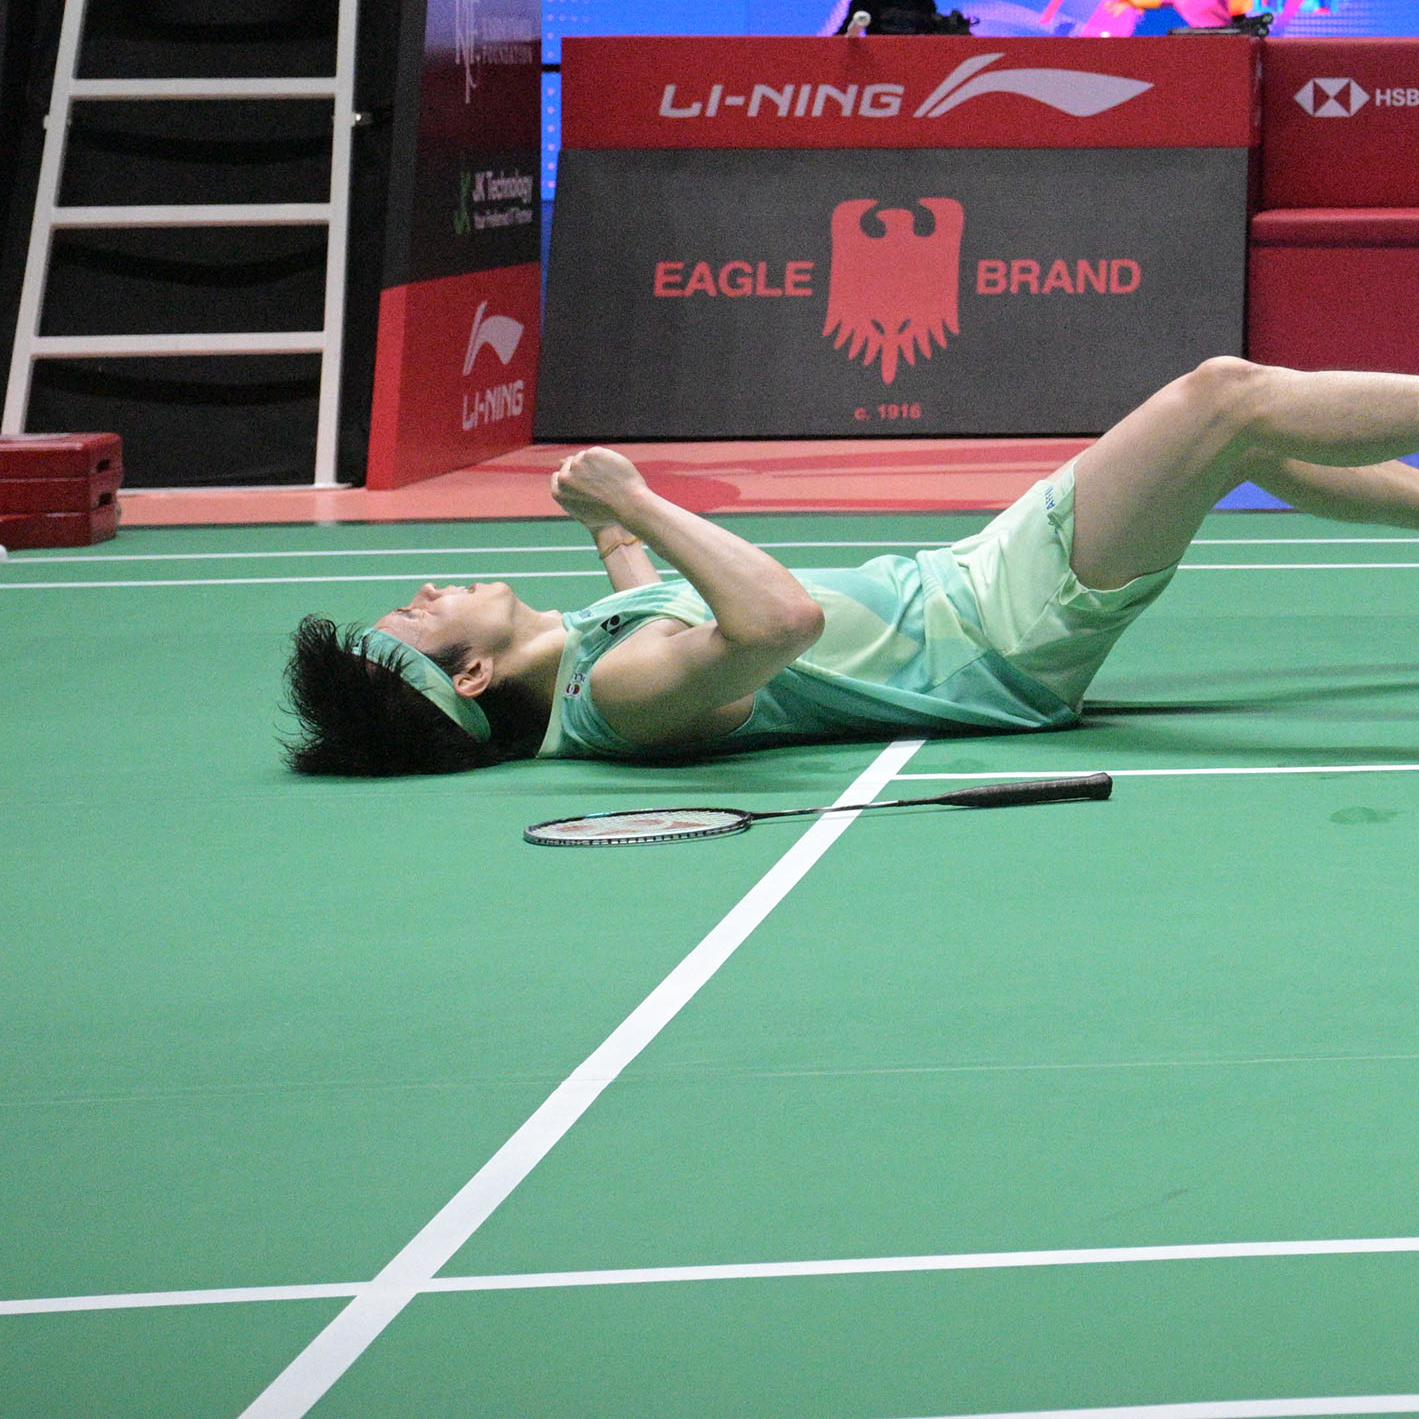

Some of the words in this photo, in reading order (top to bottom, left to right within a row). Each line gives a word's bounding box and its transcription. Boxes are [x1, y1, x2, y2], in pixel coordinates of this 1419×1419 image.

[659, 83, 905, 118] LI-NING
[653, 261, 814, 298] EAGLE
[975, 259, 1142, 295] BRAND
[462, 380, 524, 431] LI-NING
[877, 403, 922, 420] 1916
